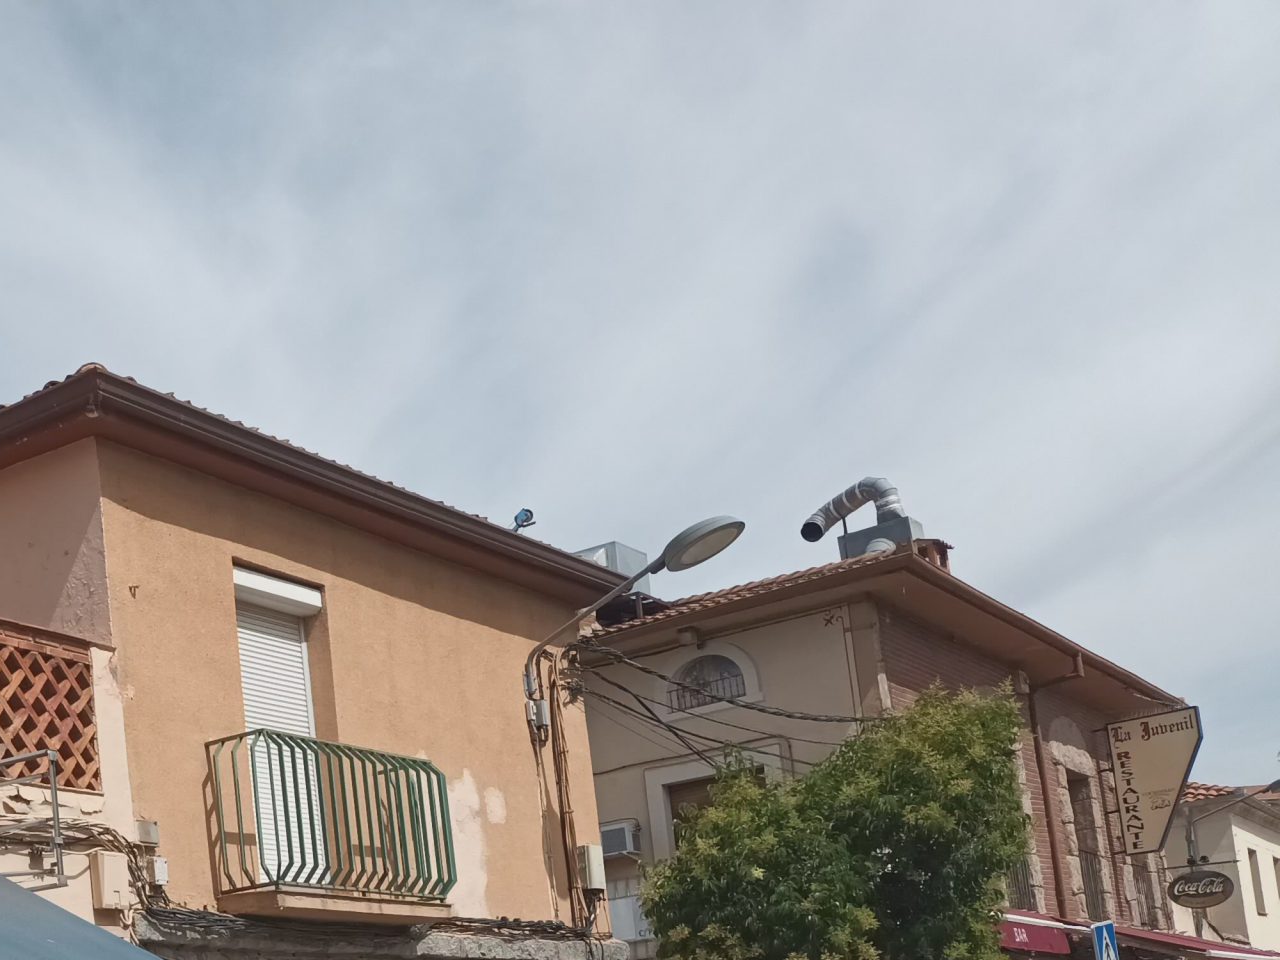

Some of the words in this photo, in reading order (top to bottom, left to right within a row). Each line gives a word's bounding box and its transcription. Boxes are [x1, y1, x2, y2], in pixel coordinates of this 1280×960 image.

[1111, 726, 1131, 743] La
[1140, 714, 1194, 741] Juvenil
[1116, 751, 1144, 850] RESTAURANTE
